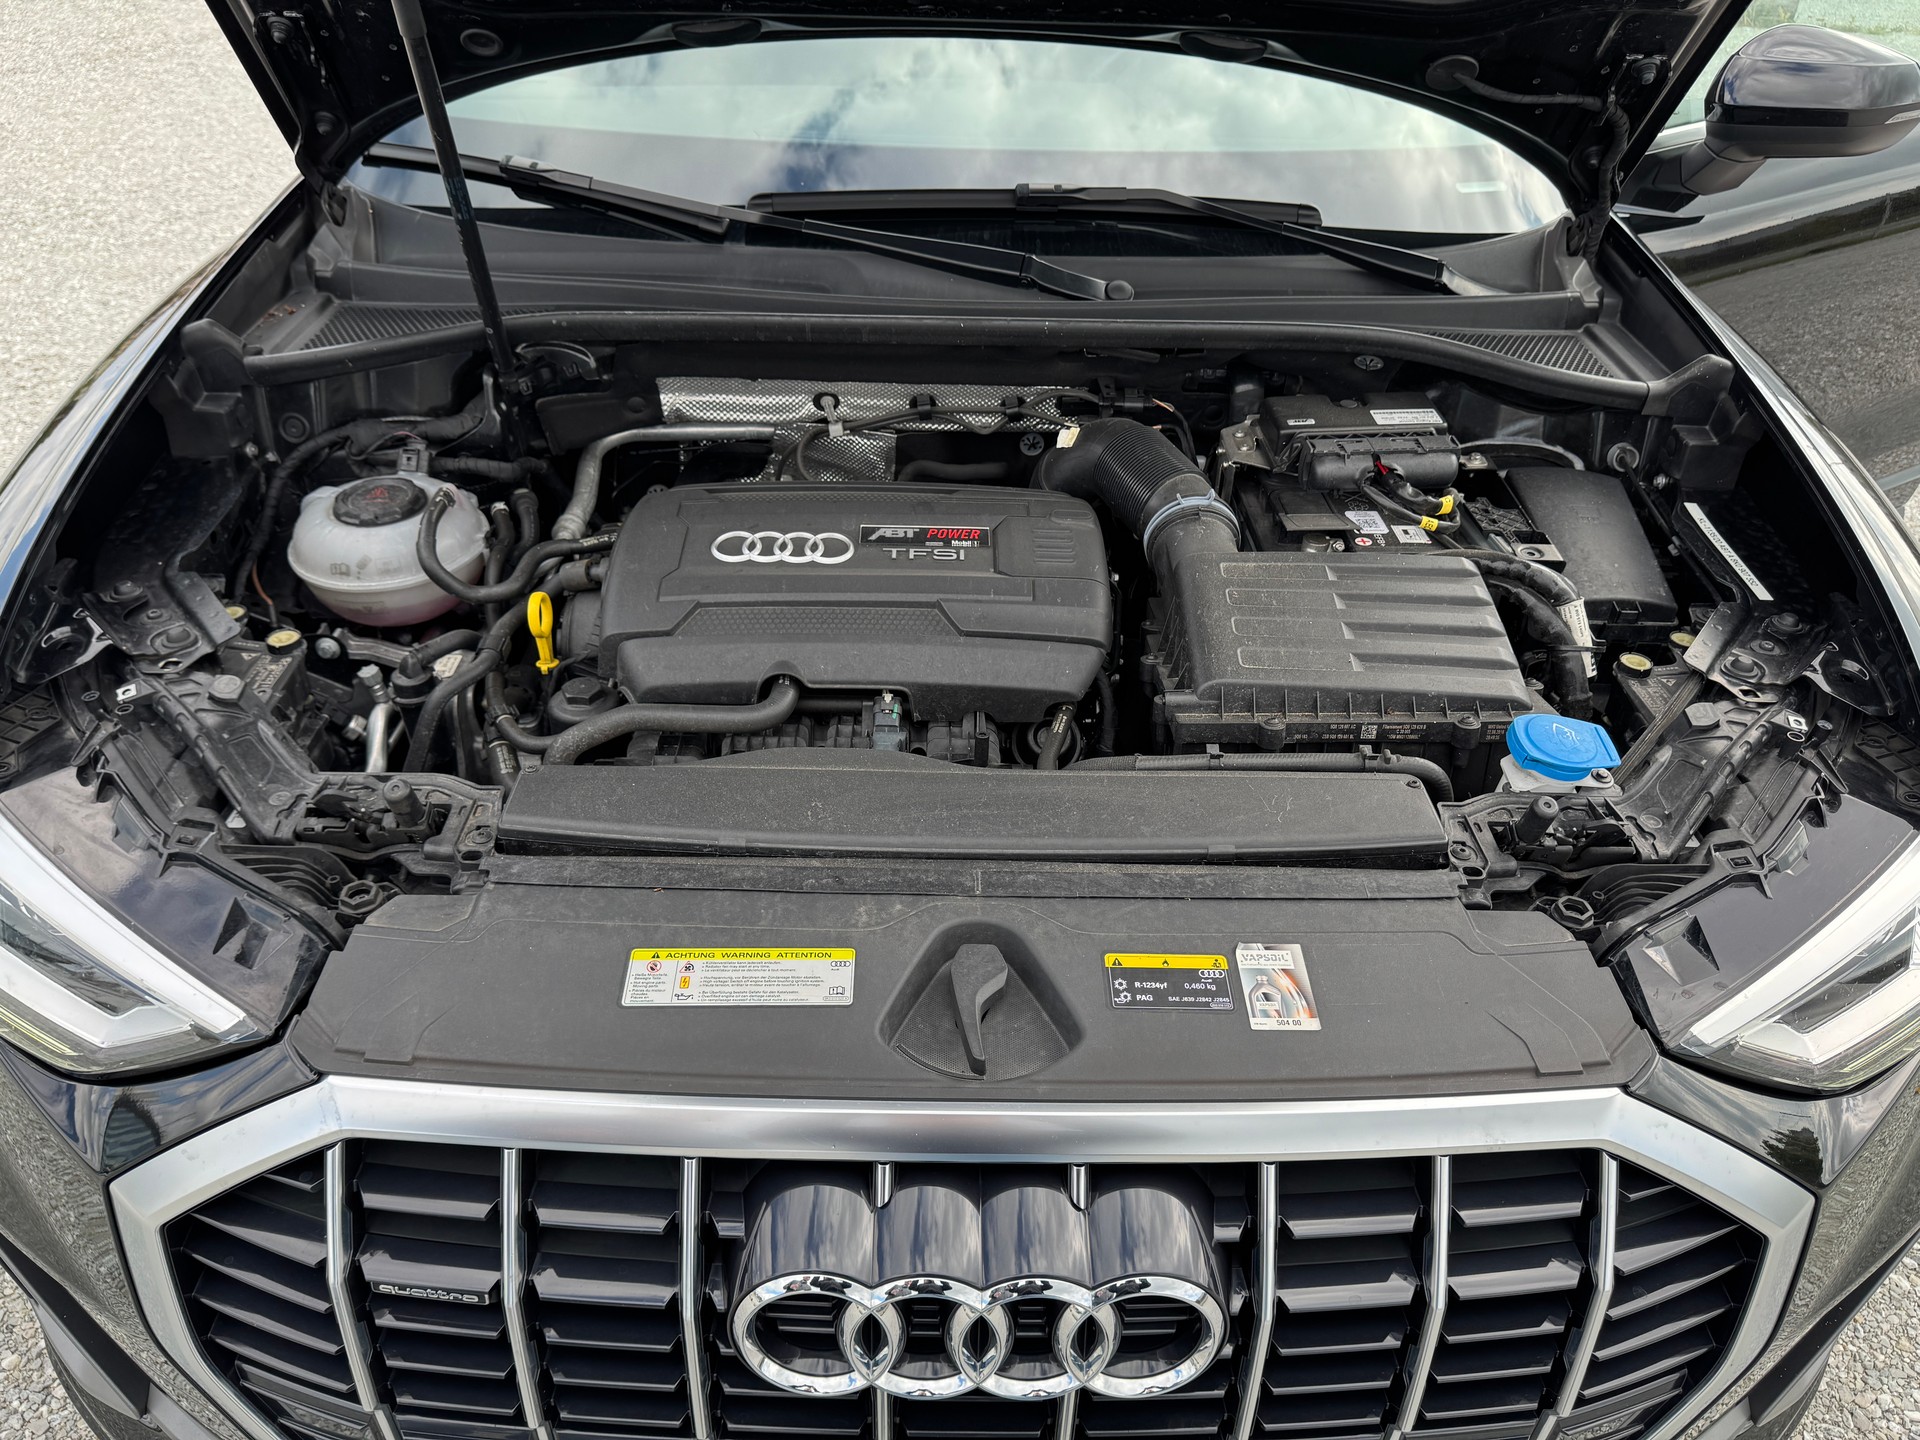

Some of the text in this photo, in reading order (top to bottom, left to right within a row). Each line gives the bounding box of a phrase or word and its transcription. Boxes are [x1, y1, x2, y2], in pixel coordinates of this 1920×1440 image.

[867, 528, 981, 540] ABT POWER
[882, 548, 965, 560] TFSI
[1134, 982, 1168, 990] R-1234yf
[379, 1284, 479, 1302] quattro
